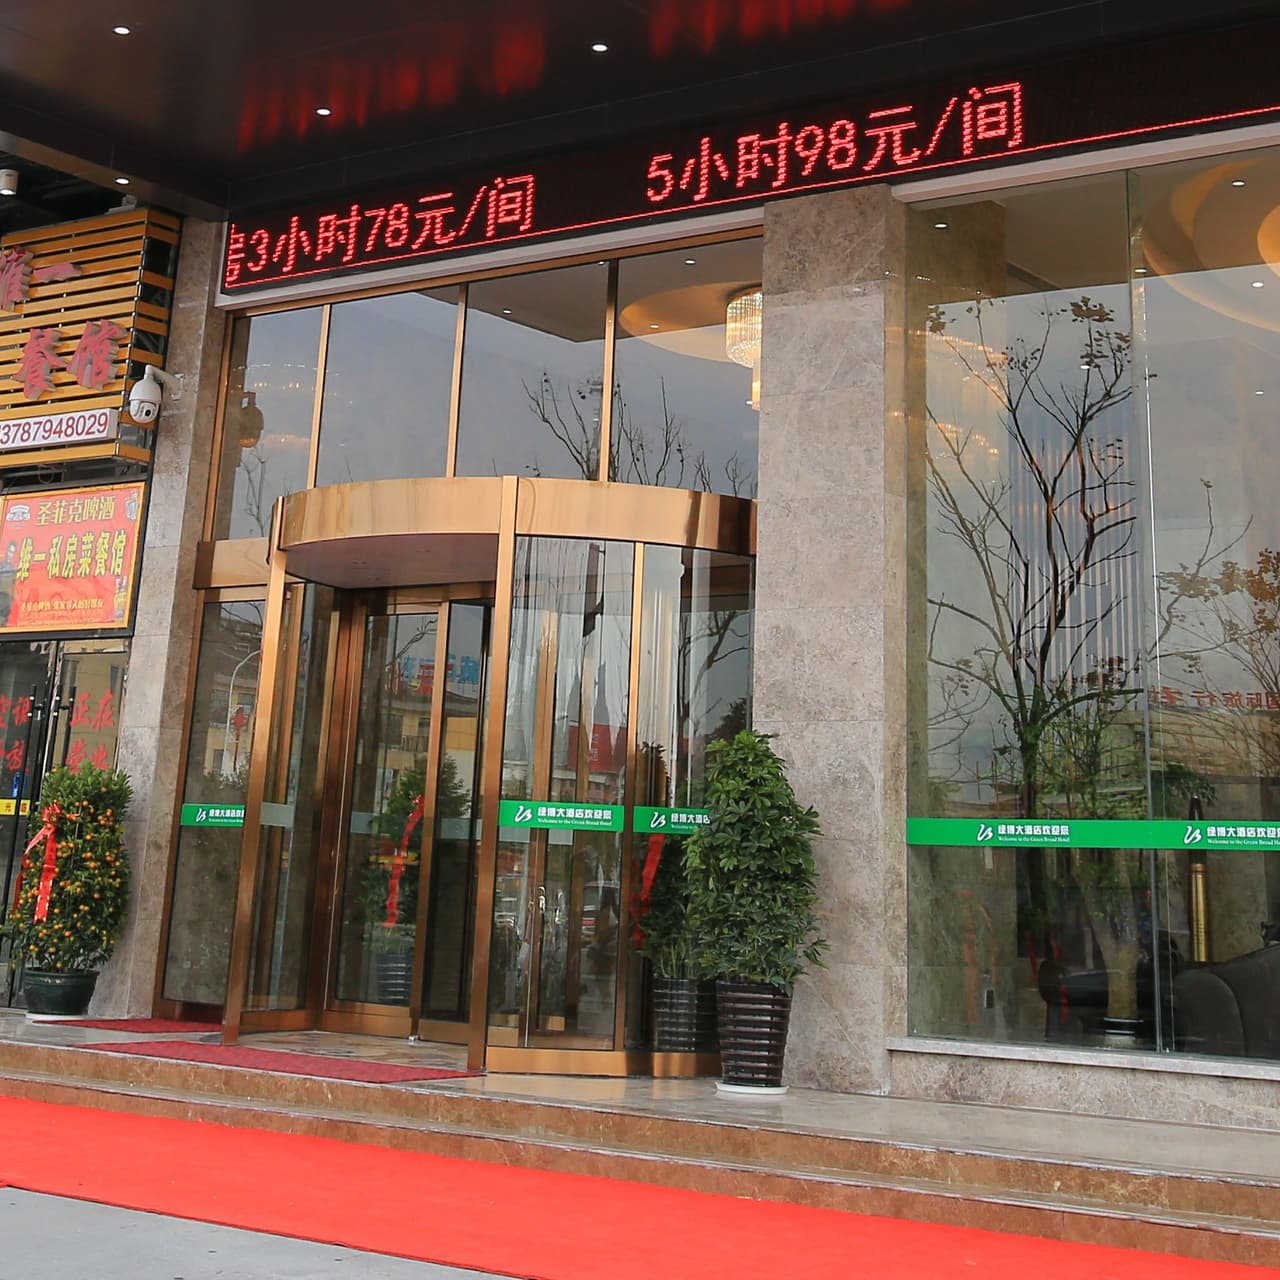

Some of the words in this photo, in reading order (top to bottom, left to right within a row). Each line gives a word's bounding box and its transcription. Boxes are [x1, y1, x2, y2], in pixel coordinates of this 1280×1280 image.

[648, 82, 1023, 201] 5小时98元/间
[12, 320, 127, 401] 餐馆
[36, 495, 115, 526] 圣菲克啤酒
